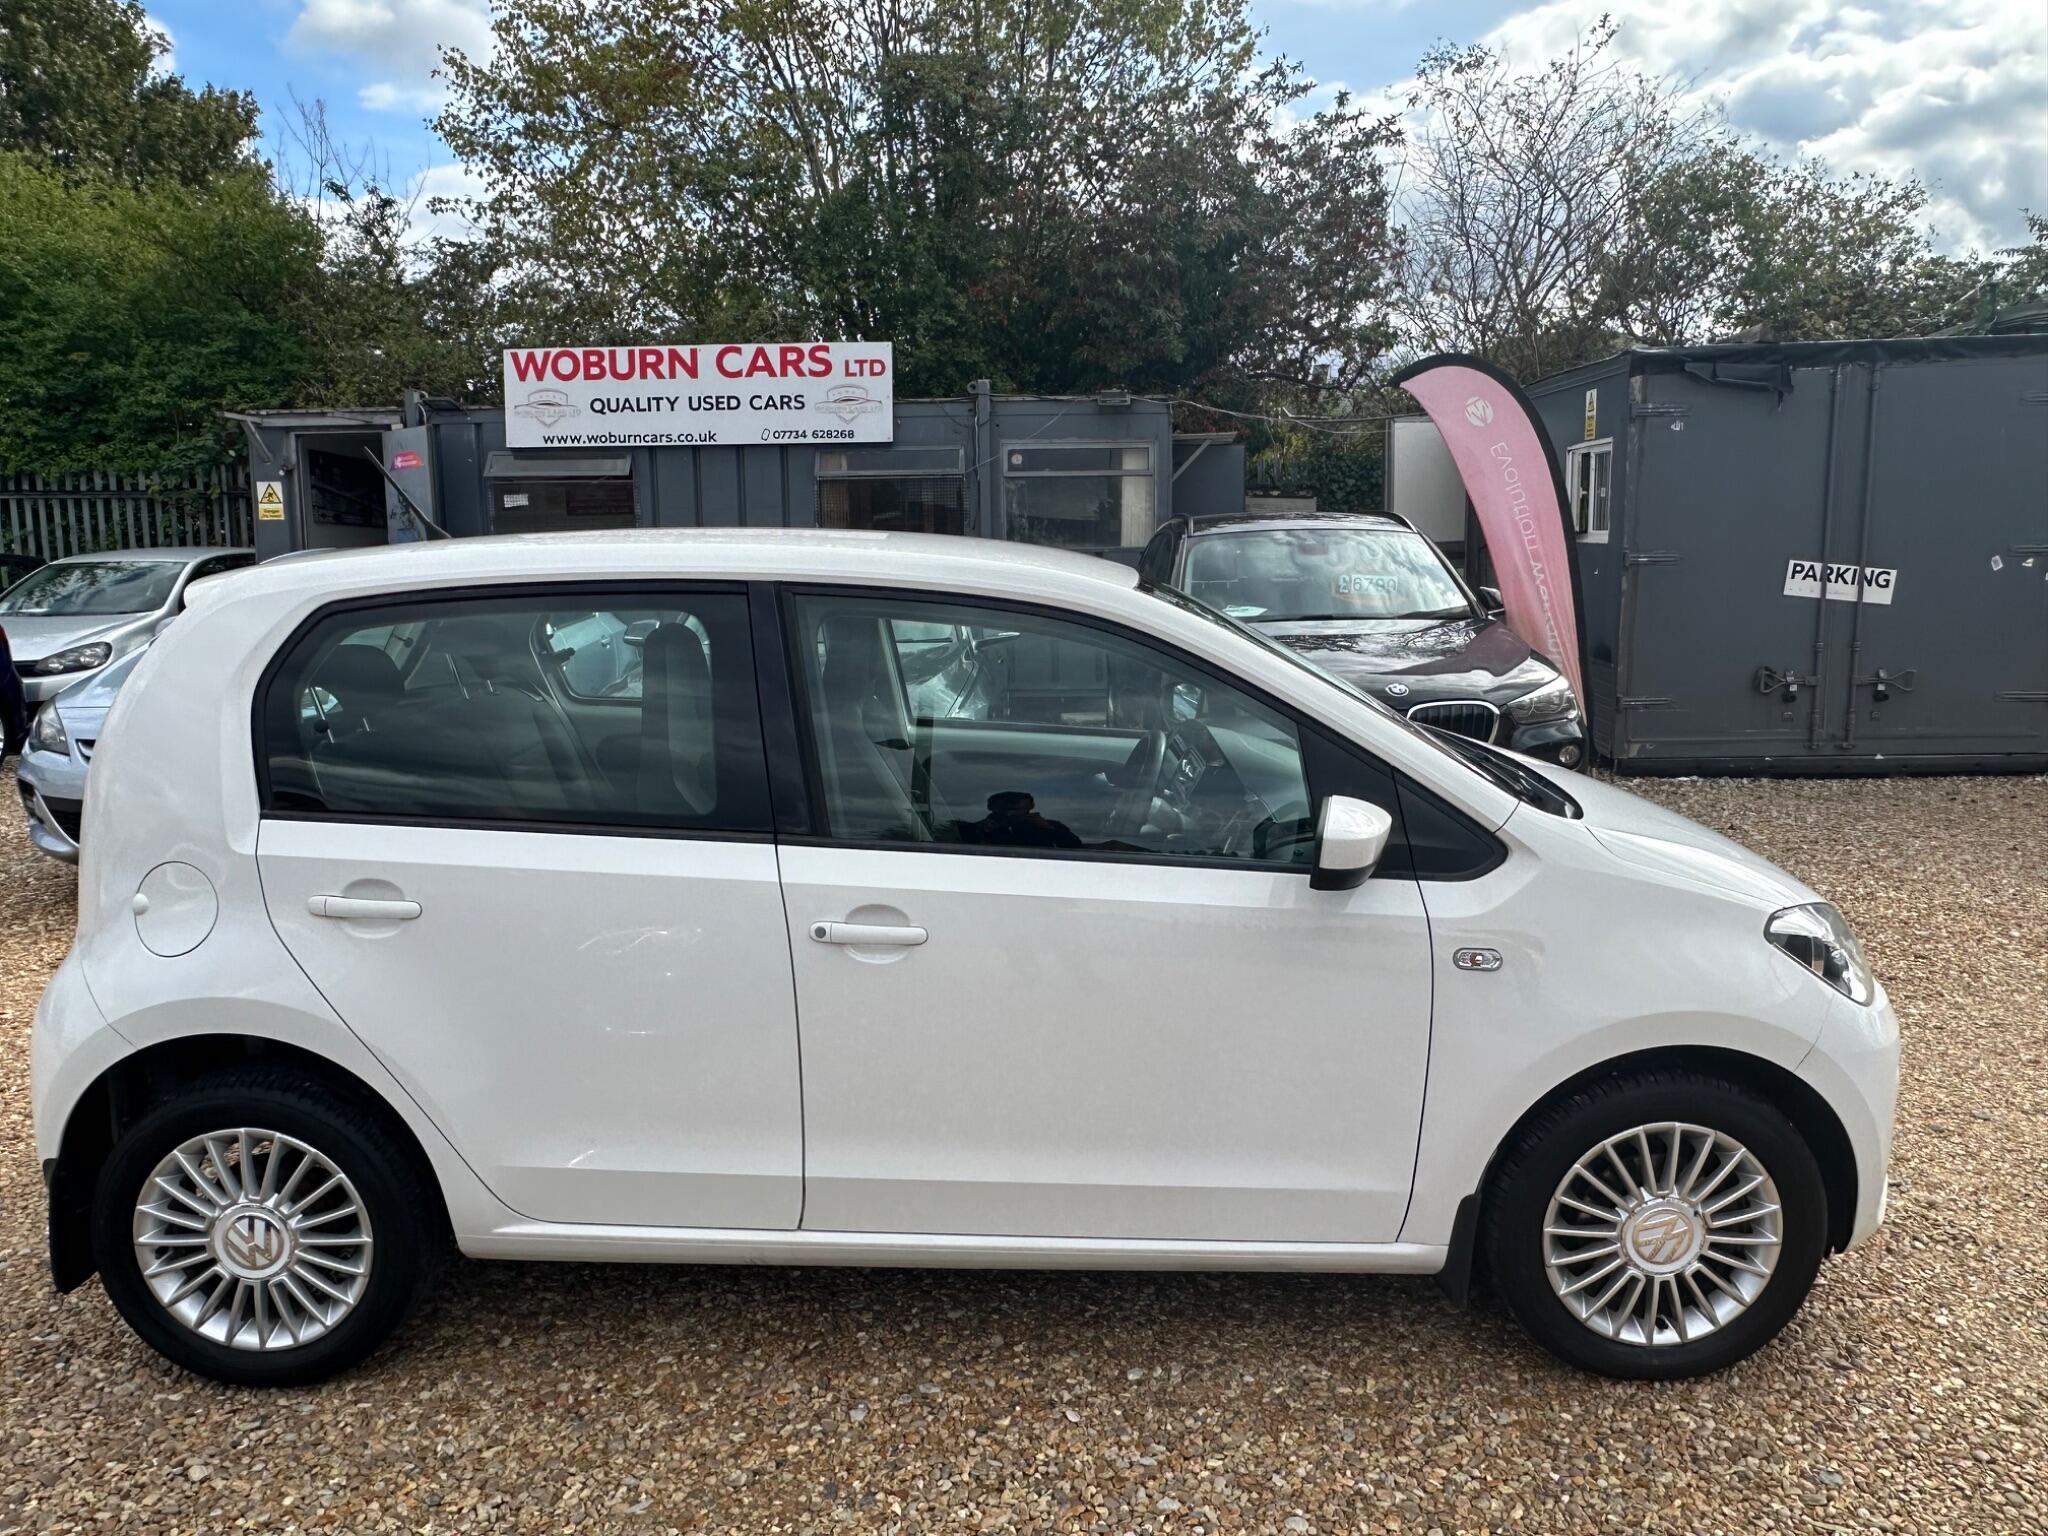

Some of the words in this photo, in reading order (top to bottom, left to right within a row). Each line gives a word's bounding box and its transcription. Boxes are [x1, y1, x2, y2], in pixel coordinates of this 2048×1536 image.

[510, 347, 699, 382] WOBURN
[715, 345, 833, 379] CARS
[844, 359, 886, 377] LTD
[590, 396, 680, 415] QUALITY
[688, 395, 741, 412] USED
[749, 394, 805, 410] CARS
[543, 430, 717, 445] www.woburncars.co.uk
[773, 430, 807, 440] 07734
[811, 429, 855, 439] 628268
[1790, 562, 1892, 589] PARKING
